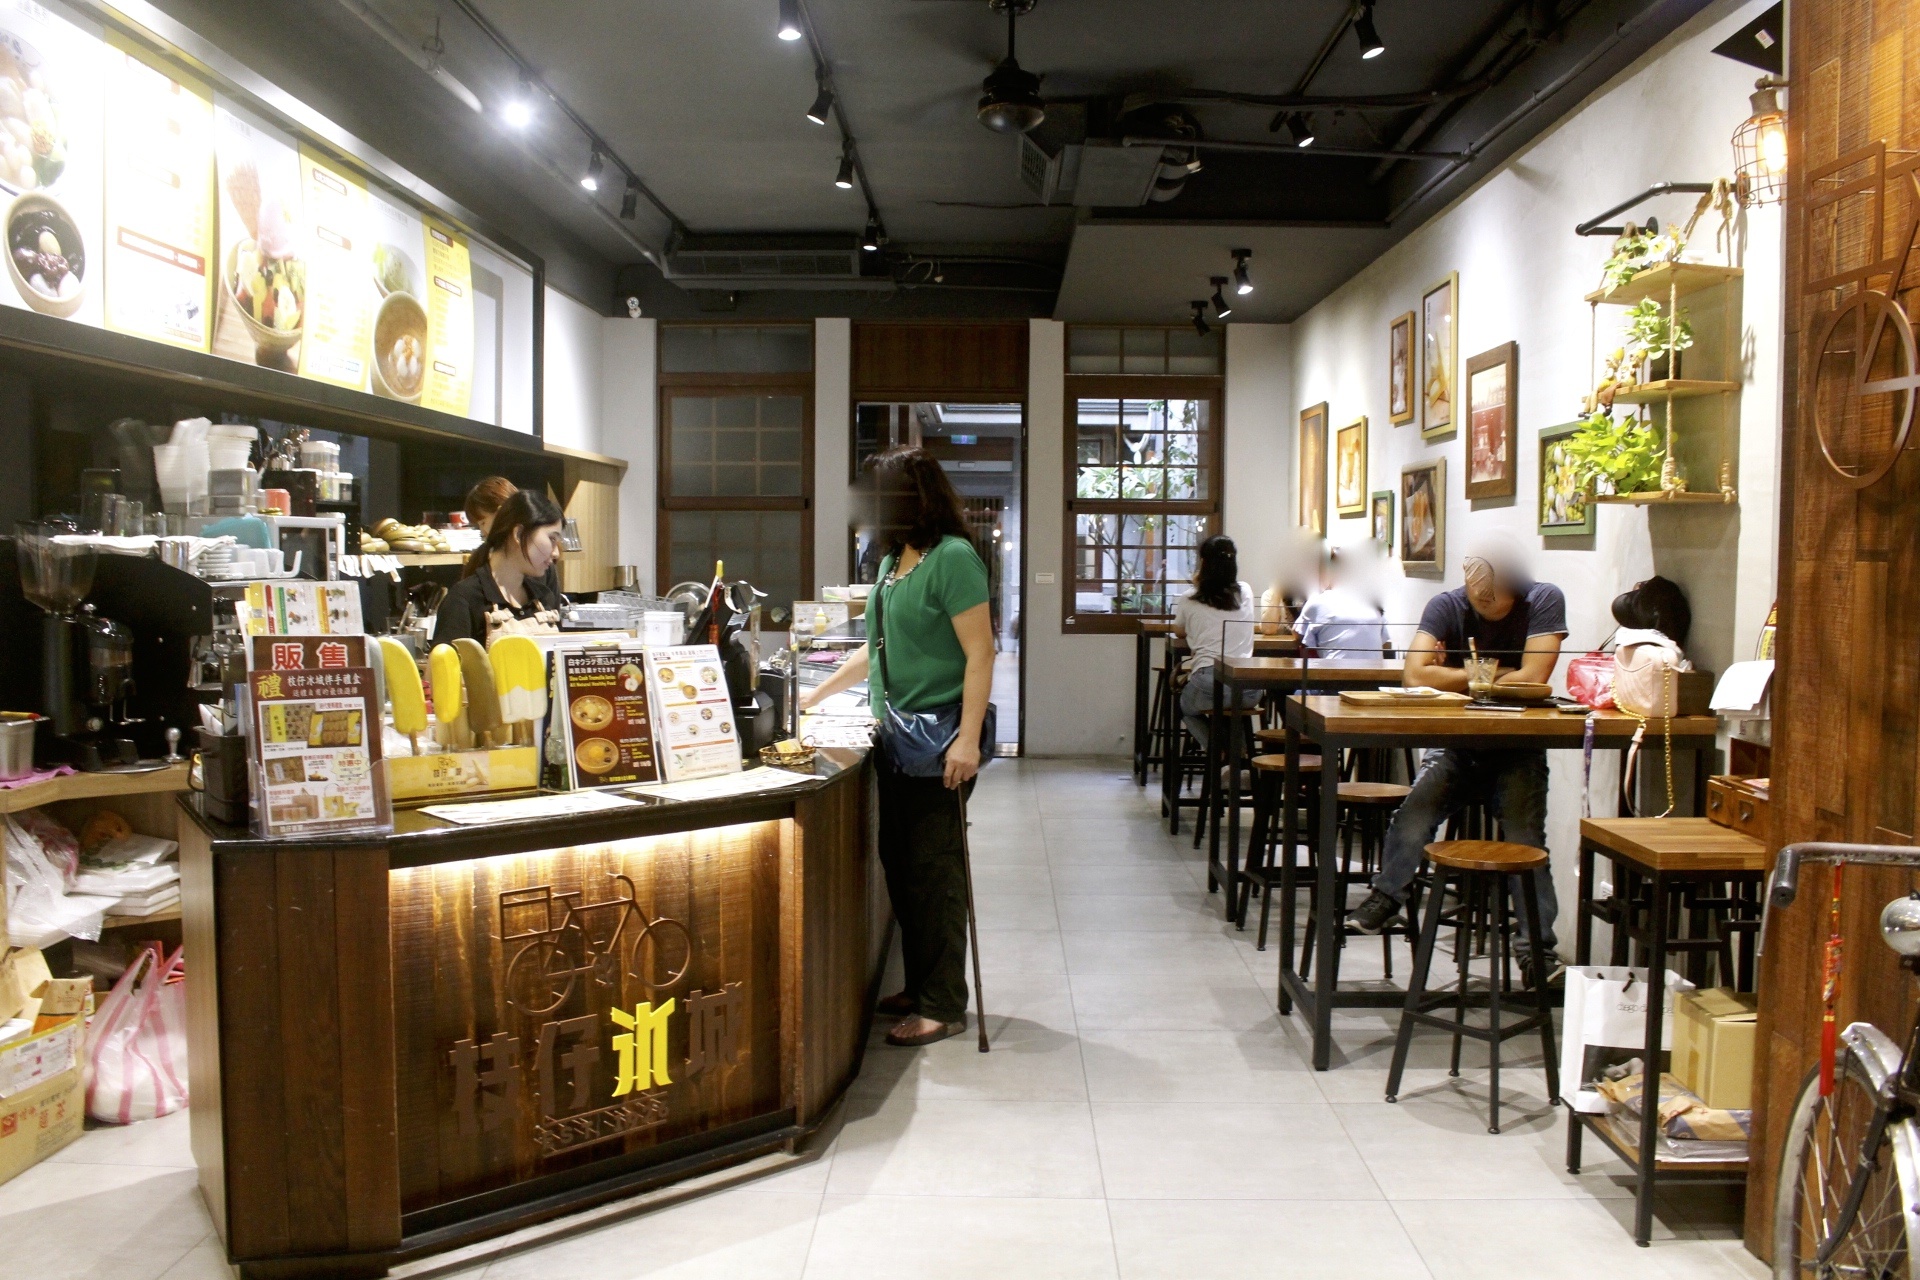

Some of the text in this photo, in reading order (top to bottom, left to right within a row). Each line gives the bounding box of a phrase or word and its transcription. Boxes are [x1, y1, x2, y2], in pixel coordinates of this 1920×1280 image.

[272, 643, 347, 669] 販售
[257, 673, 285, 699] 禮
[448, 981, 743, 1137] 枝仔冰城
